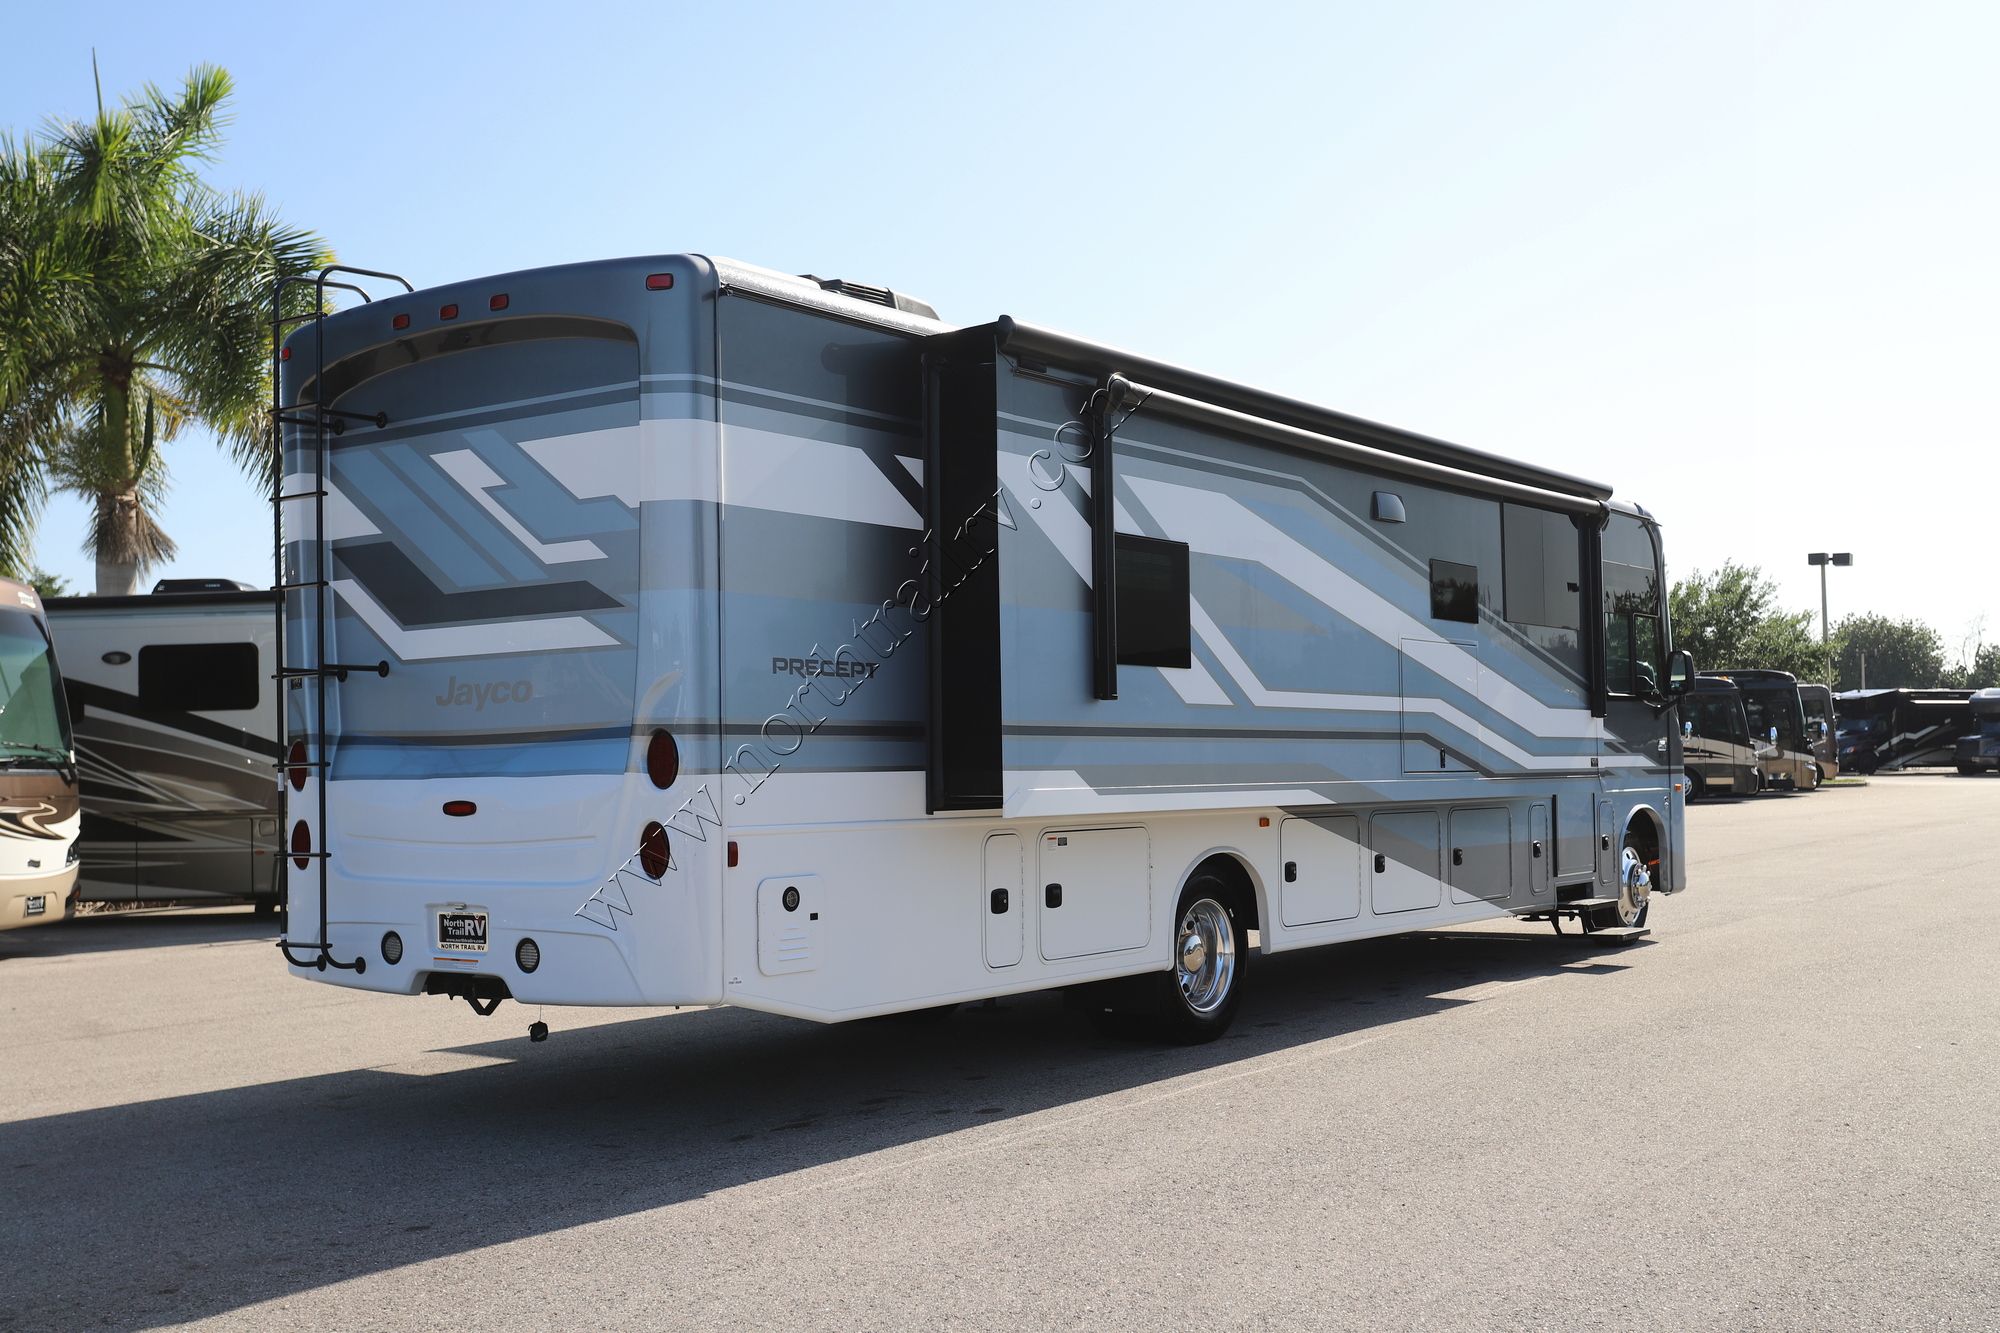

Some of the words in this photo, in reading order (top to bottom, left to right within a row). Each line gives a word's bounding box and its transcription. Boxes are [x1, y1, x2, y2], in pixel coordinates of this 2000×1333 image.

[772, 656, 878, 679] PRECEPT
[435, 675, 533, 712] Jayco
[443, 919, 464, 927] North
[464, 919, 485, 936] RV
